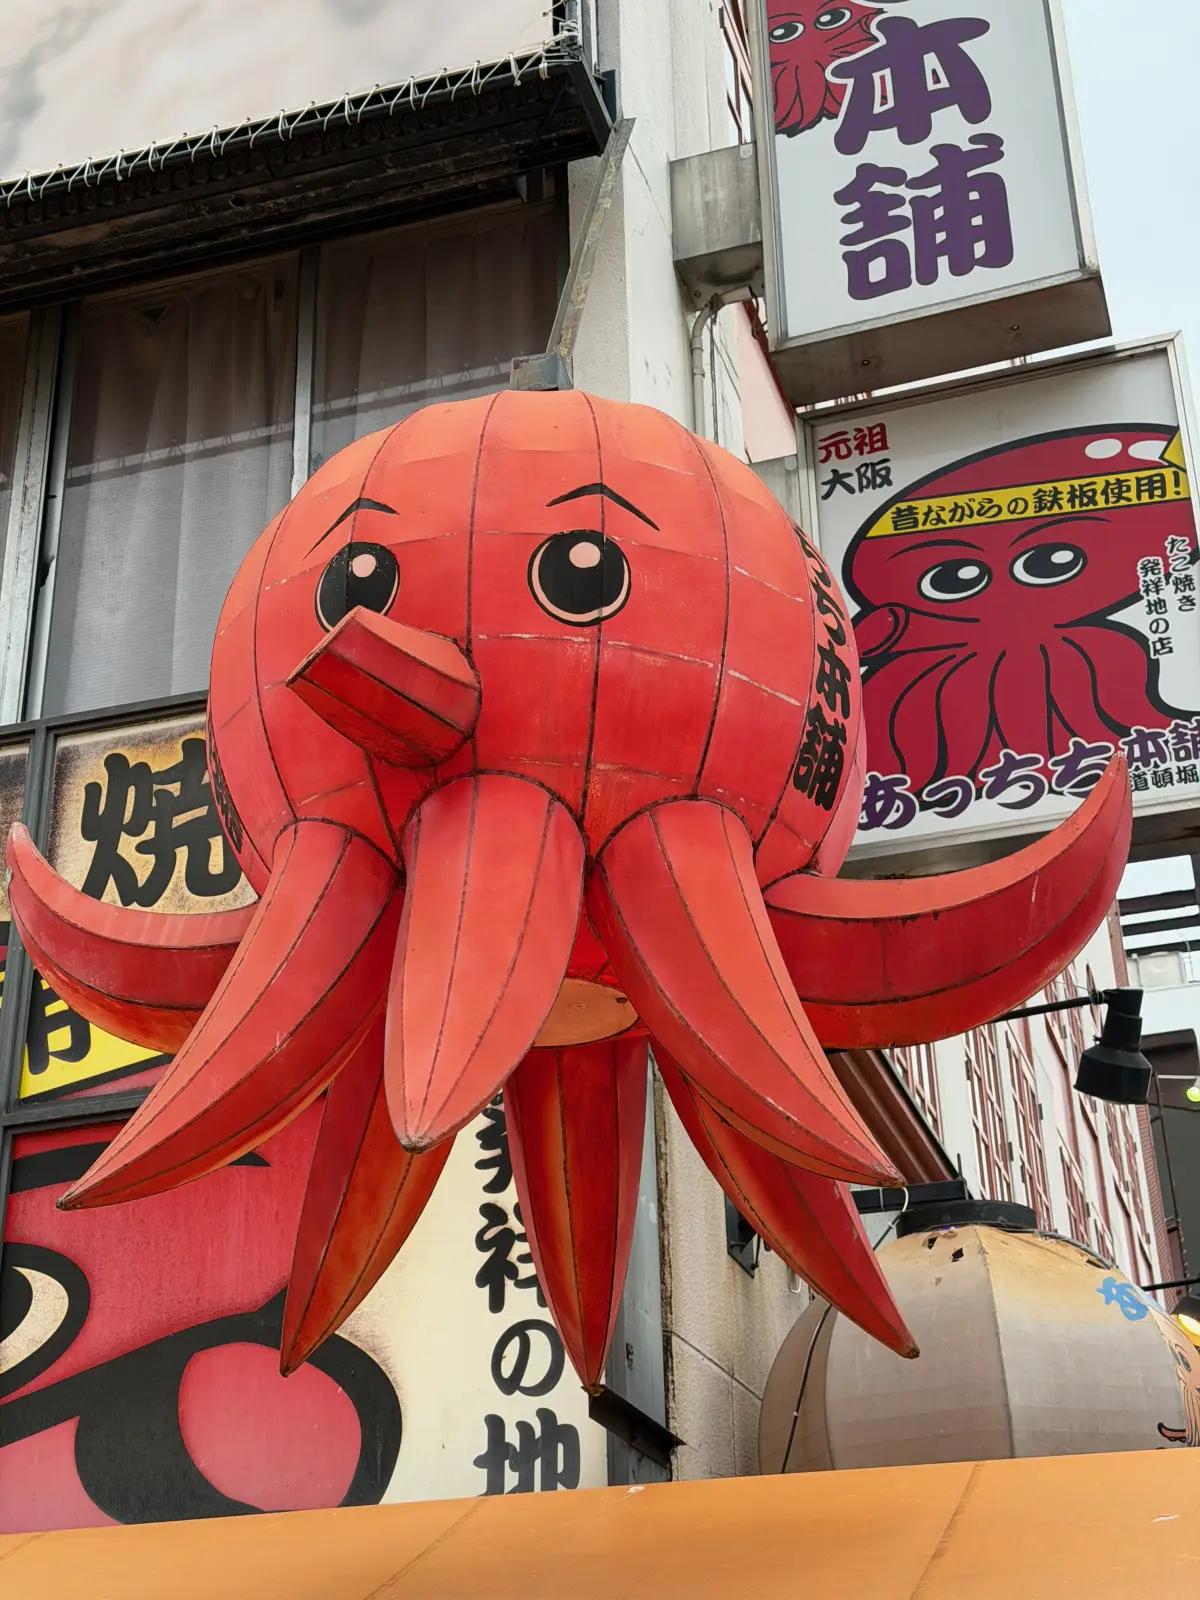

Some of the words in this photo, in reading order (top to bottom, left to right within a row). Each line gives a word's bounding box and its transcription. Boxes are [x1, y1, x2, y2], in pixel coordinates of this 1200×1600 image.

[833, 16, 1014, 301] 本舗
[817, 422, 890, 464] 元祖
[820, 457, 893, 501] 大阪
[890, 471, 1182, 532] 昔ながらの鉄板使用!
[1166, 536, 1197, 612] たこ焼き
[1139, 558, 1174, 657] 発祥地の店
[1129, 763, 1199, 792] 道頓堀
